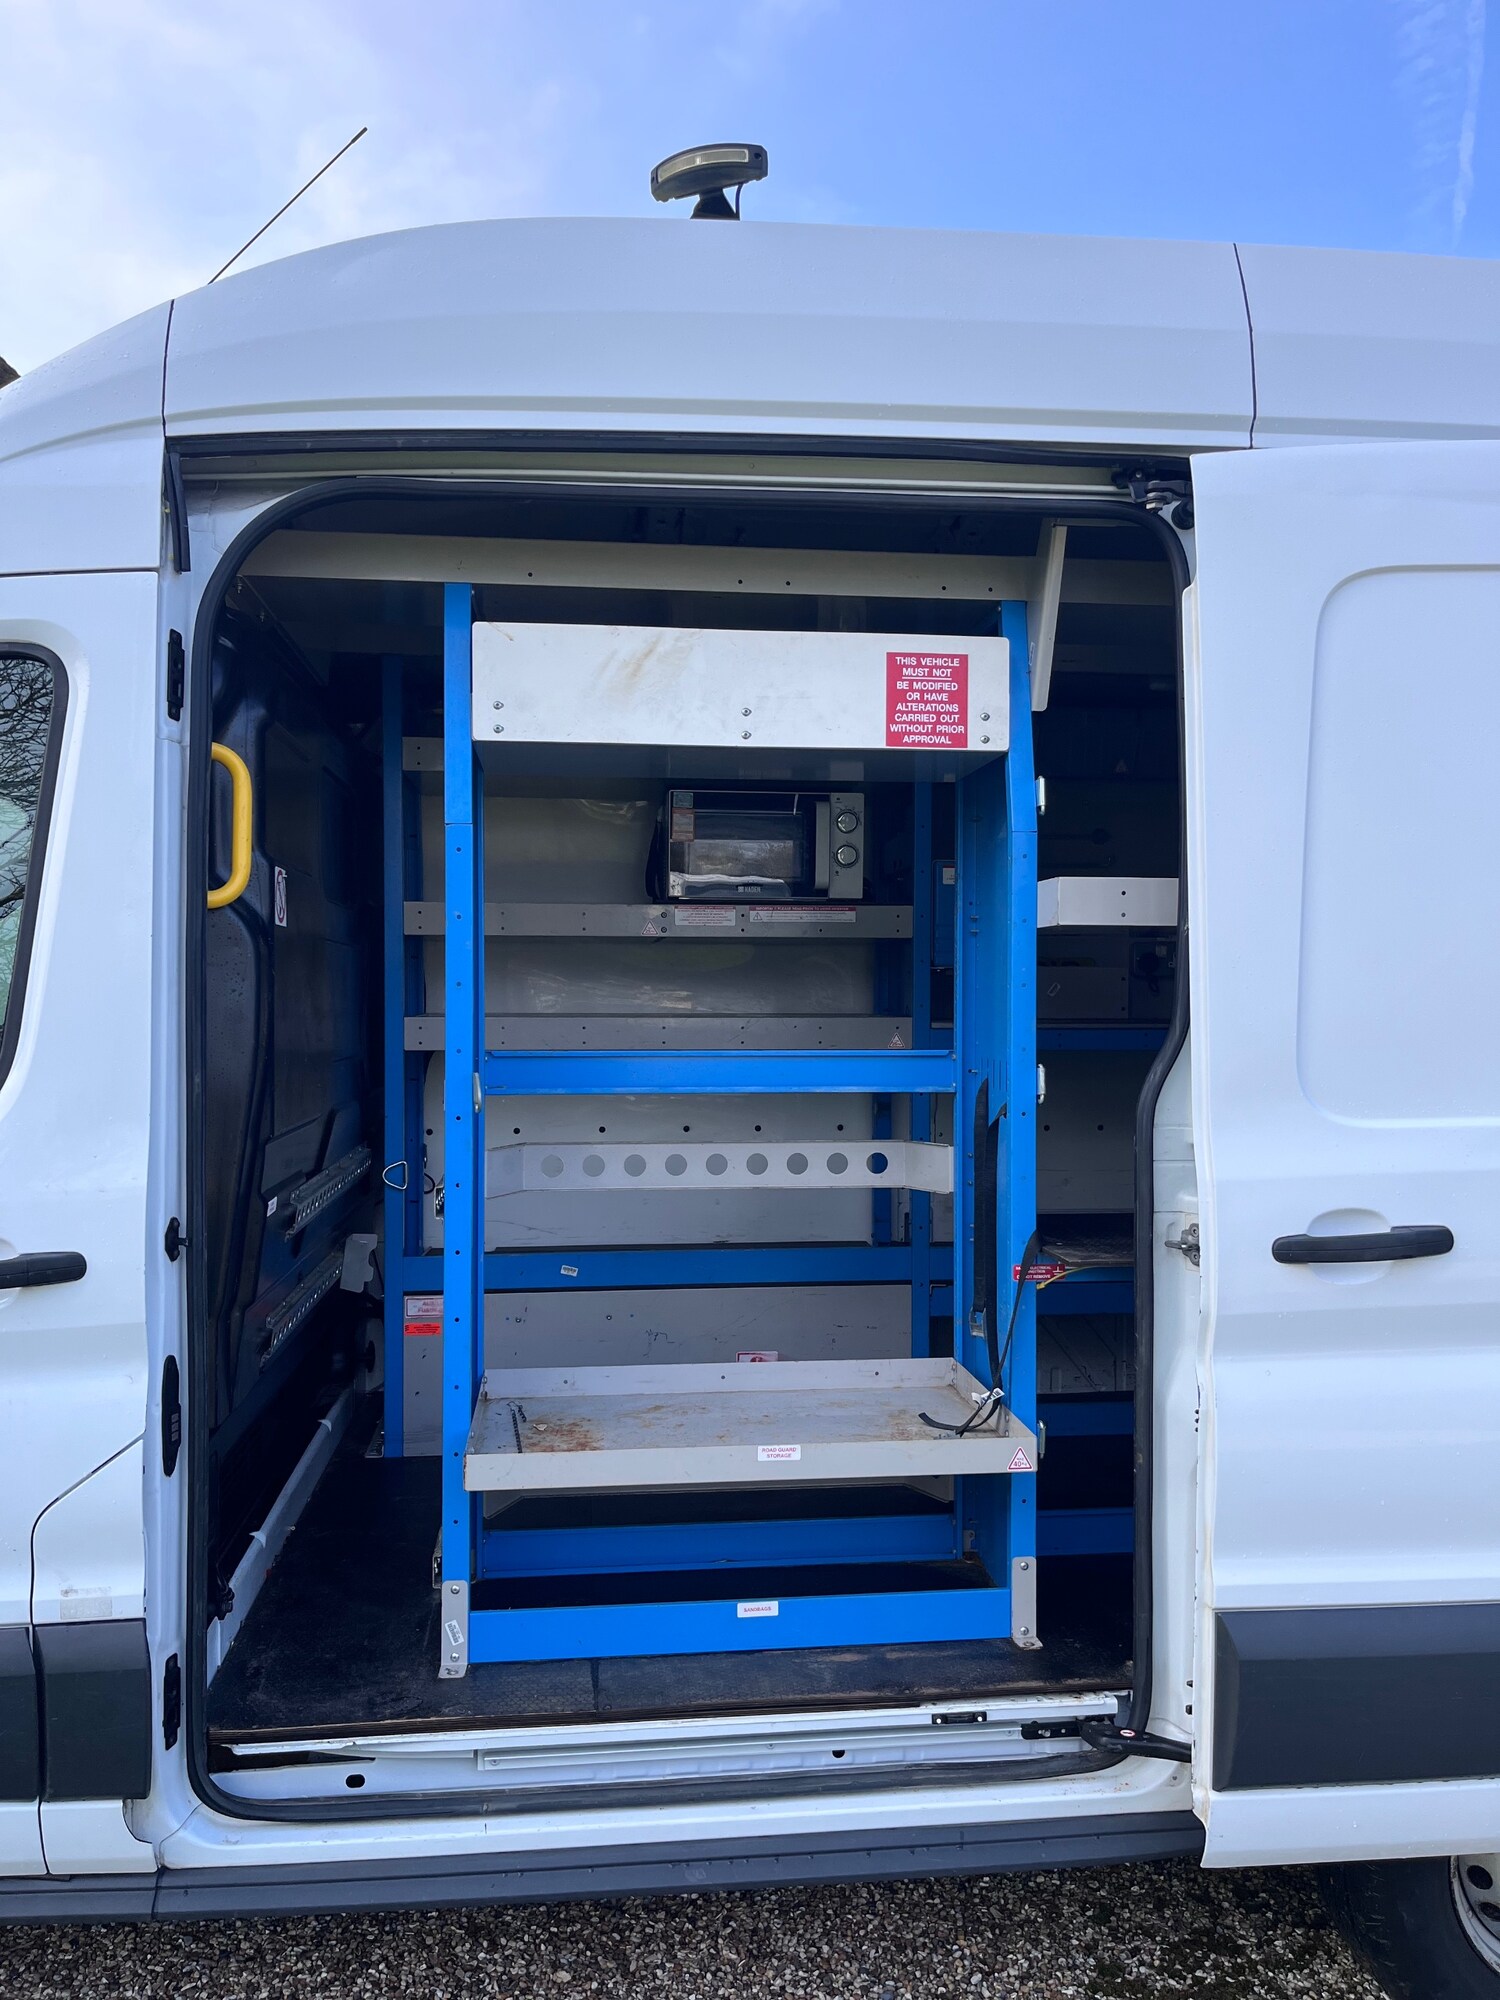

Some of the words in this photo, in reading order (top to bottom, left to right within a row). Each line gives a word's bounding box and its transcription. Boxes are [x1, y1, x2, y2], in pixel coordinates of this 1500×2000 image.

[895, 657, 917, 665] THIS
[920, 658, 960, 667] VEHICLE
[902, 668, 929, 676] MUST
[932, 668, 952, 677] NOT
[896, 681, 909, 690] BE
[913, 682, 958, 691] MODIFIED
[906, 692, 920, 700] OR
[923, 692, 949, 701] HAVE
[896, 703, 959, 712] ALTERATIONS
[894, 713, 937, 723] CARRIED
[940, 714, 960, 723] OUT
[889, 723, 933, 733] WITHOUT
[936, 725, 965, 734] PRIOR
[902, 735, 952, 744] APPROVAL
